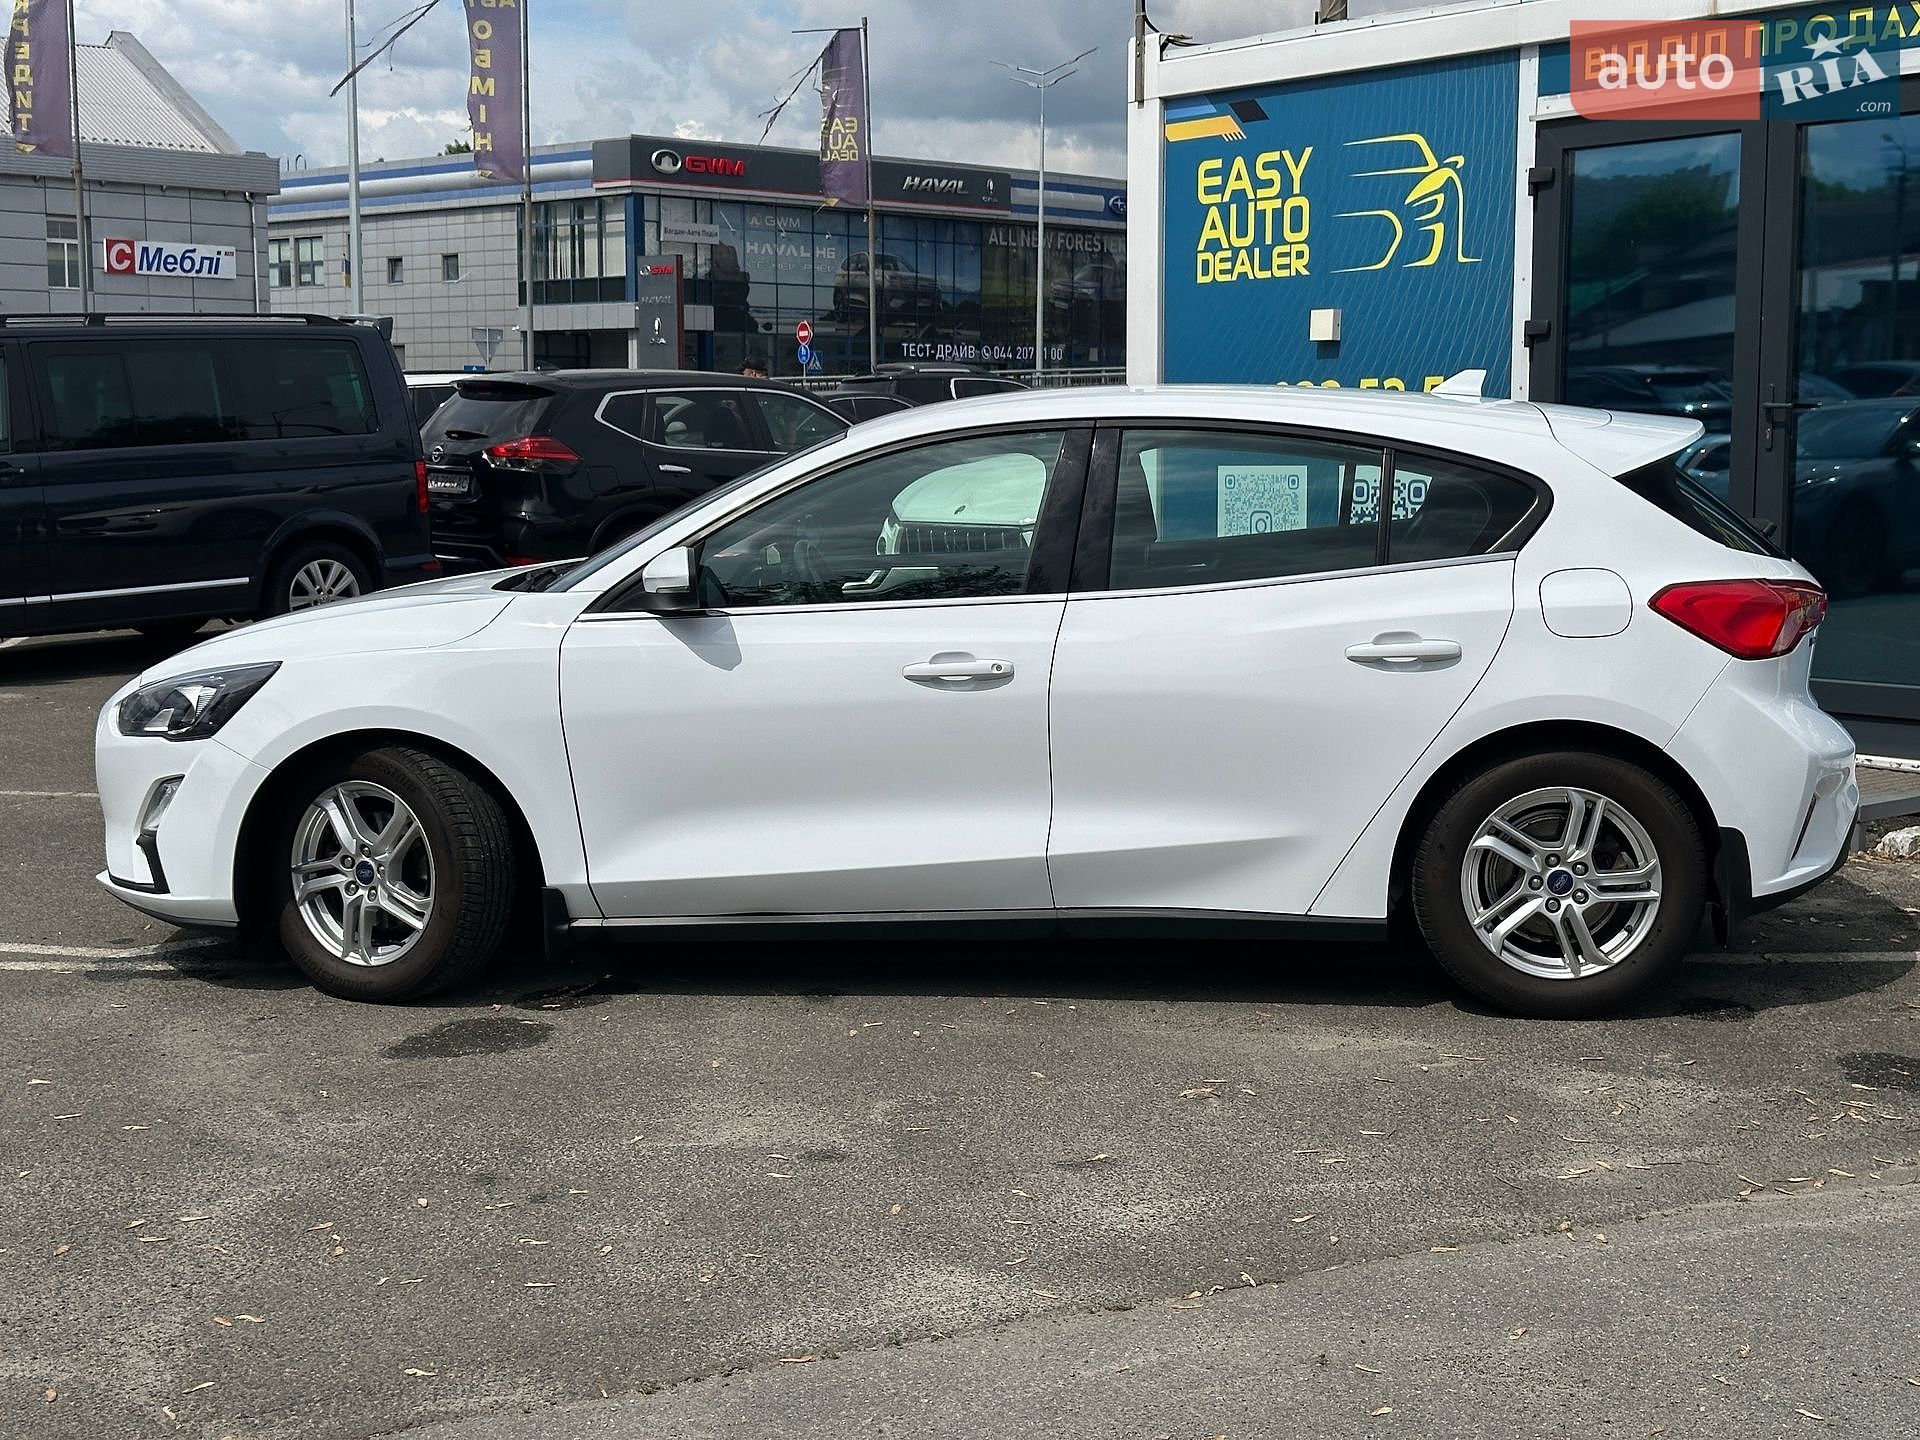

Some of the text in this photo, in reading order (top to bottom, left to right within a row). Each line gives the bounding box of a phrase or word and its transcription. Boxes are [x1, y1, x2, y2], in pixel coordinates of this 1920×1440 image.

[1744, 1, 1920, 59] ПРОДА
[685, 155, 745, 177] GWM
[1197, 146, 1314, 205] EASY
[902, 176, 969, 194] HAVAL
[1197, 196, 1311, 251] AUTO
[988, 227, 1017, 246] ALL
[138, 246, 221, 275] Меблі
[746, 242, 836, 259] HAVAL H6
[1196, 243, 1311, 284] DEALER
[902, 342, 976, 361] ТЕСТ-ДРАЙВ
[993, 345, 1013, 360] 044
[1016, 346, 1035, 360] 207
[1050, 347, 1064, 361] 00
